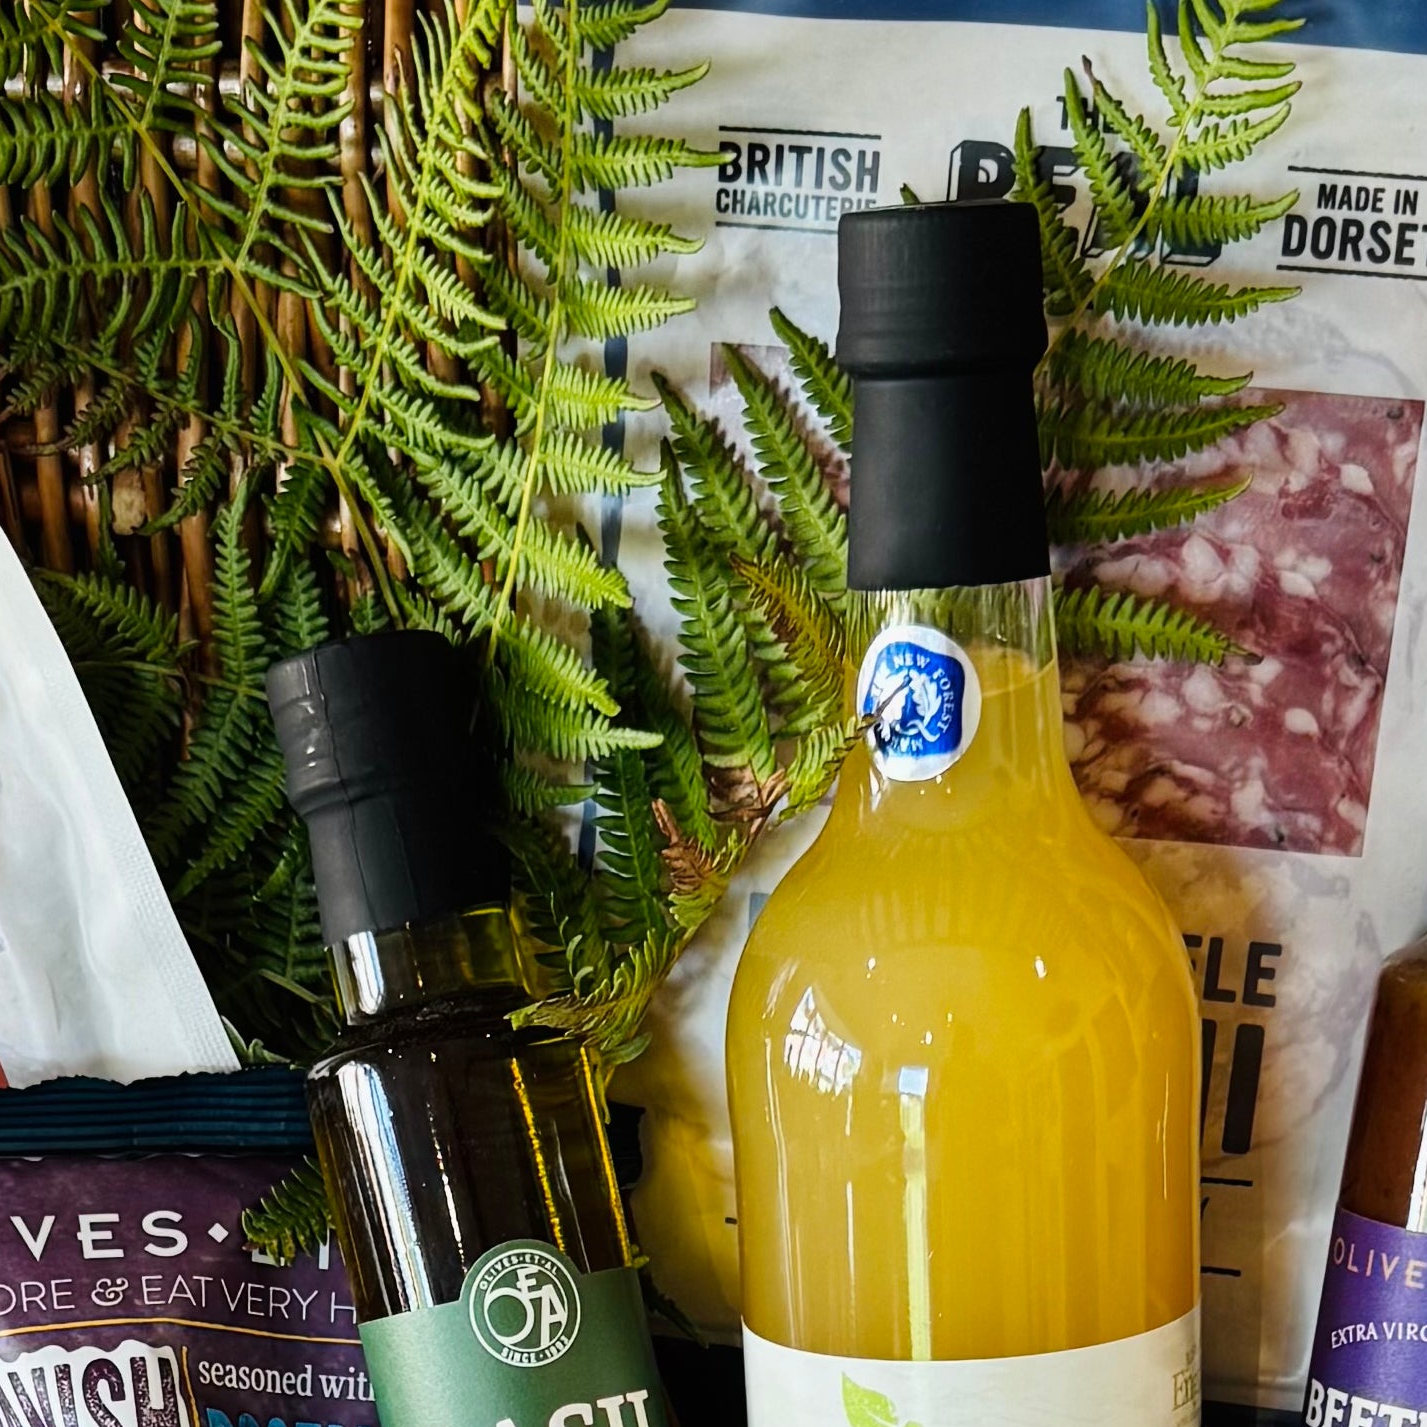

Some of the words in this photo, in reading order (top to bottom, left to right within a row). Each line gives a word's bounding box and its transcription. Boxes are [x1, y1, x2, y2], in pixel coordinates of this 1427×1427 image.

[718, 140, 881, 191] BRITISH
[1317, 183, 1389, 212] MADE
[1395, 188, 1418, 214] IN
[1331, 1322, 1377, 1348] EXTRA
